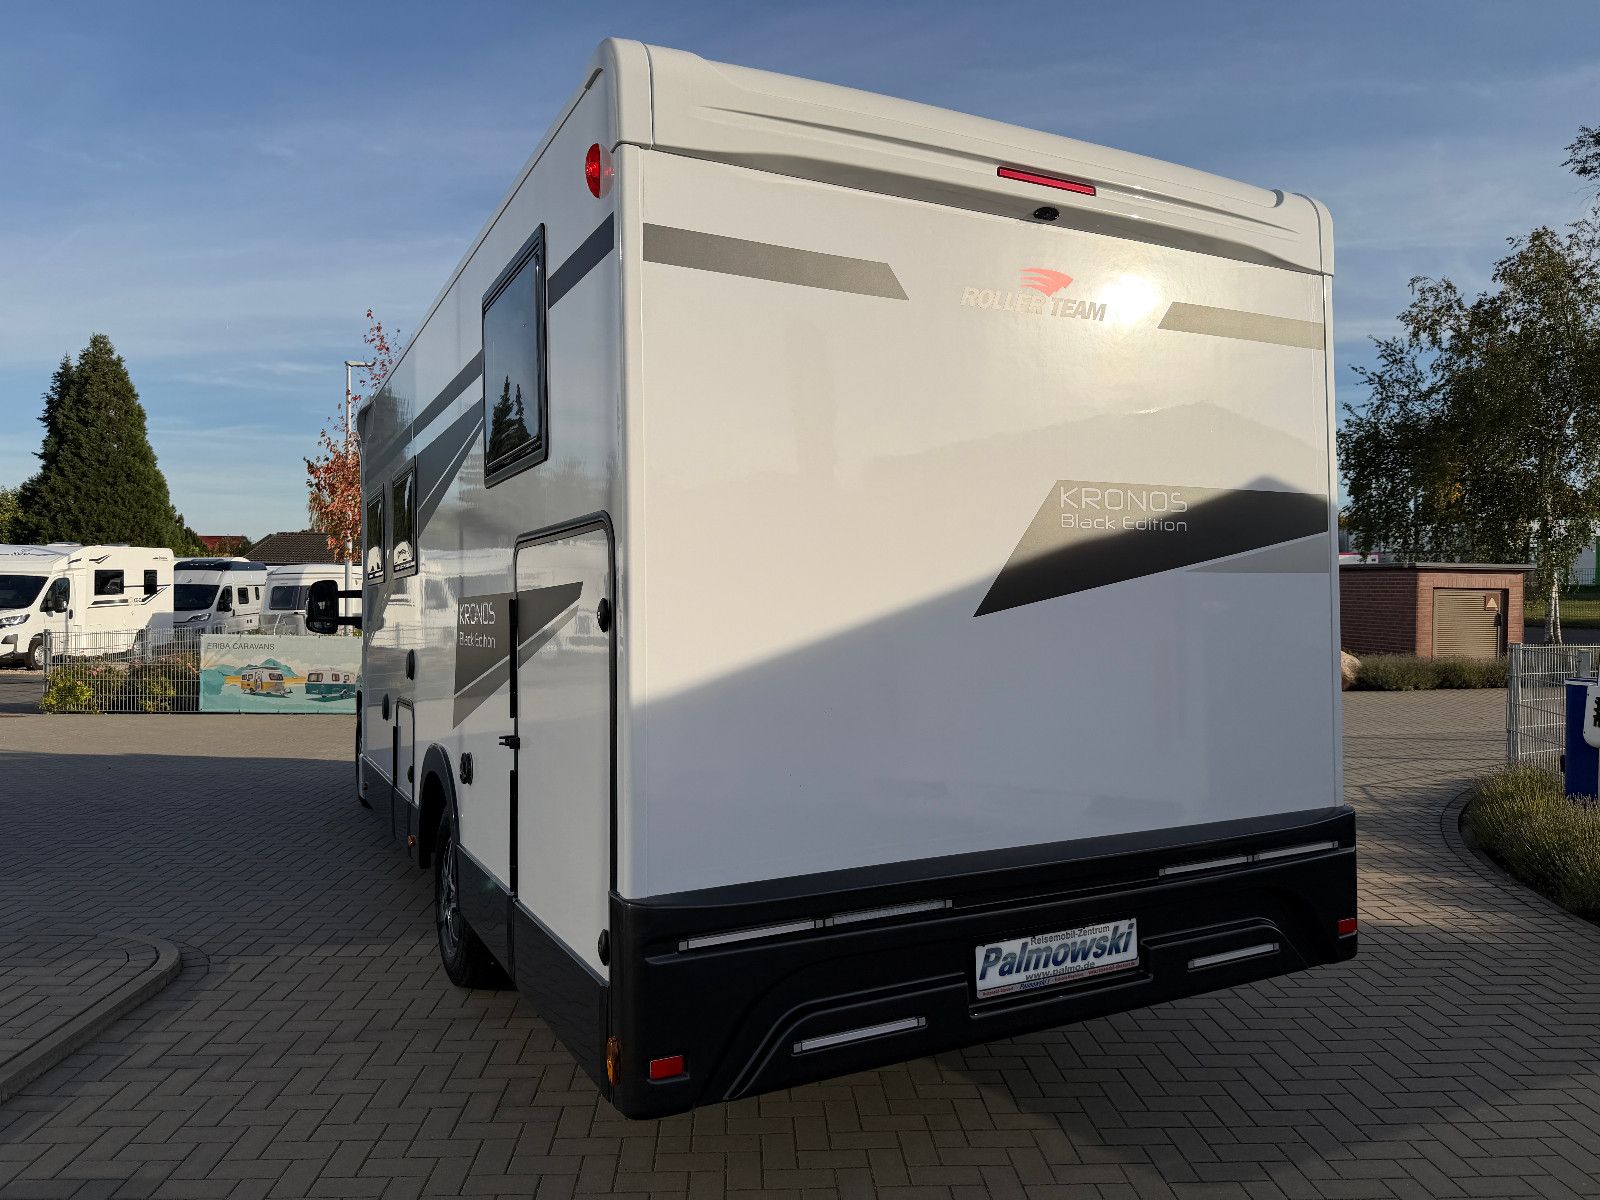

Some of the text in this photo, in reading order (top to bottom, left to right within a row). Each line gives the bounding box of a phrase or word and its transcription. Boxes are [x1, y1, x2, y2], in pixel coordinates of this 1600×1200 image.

[960, 286, 1108, 321] ROLLER TEAM
[1060, 487, 1188, 513] KRONOS
[1061, 513, 1188, 532] Black Edition
[459, 602, 496, 625] KRONOS
[207, 642, 275, 651] ERIBA CARAVANS
[1030, 924, 1110, 946] Reisemobil-Zentrum
[978, 922, 1135, 981] Palmowski
[1025, 960, 1096, 981] www.palmo.de
